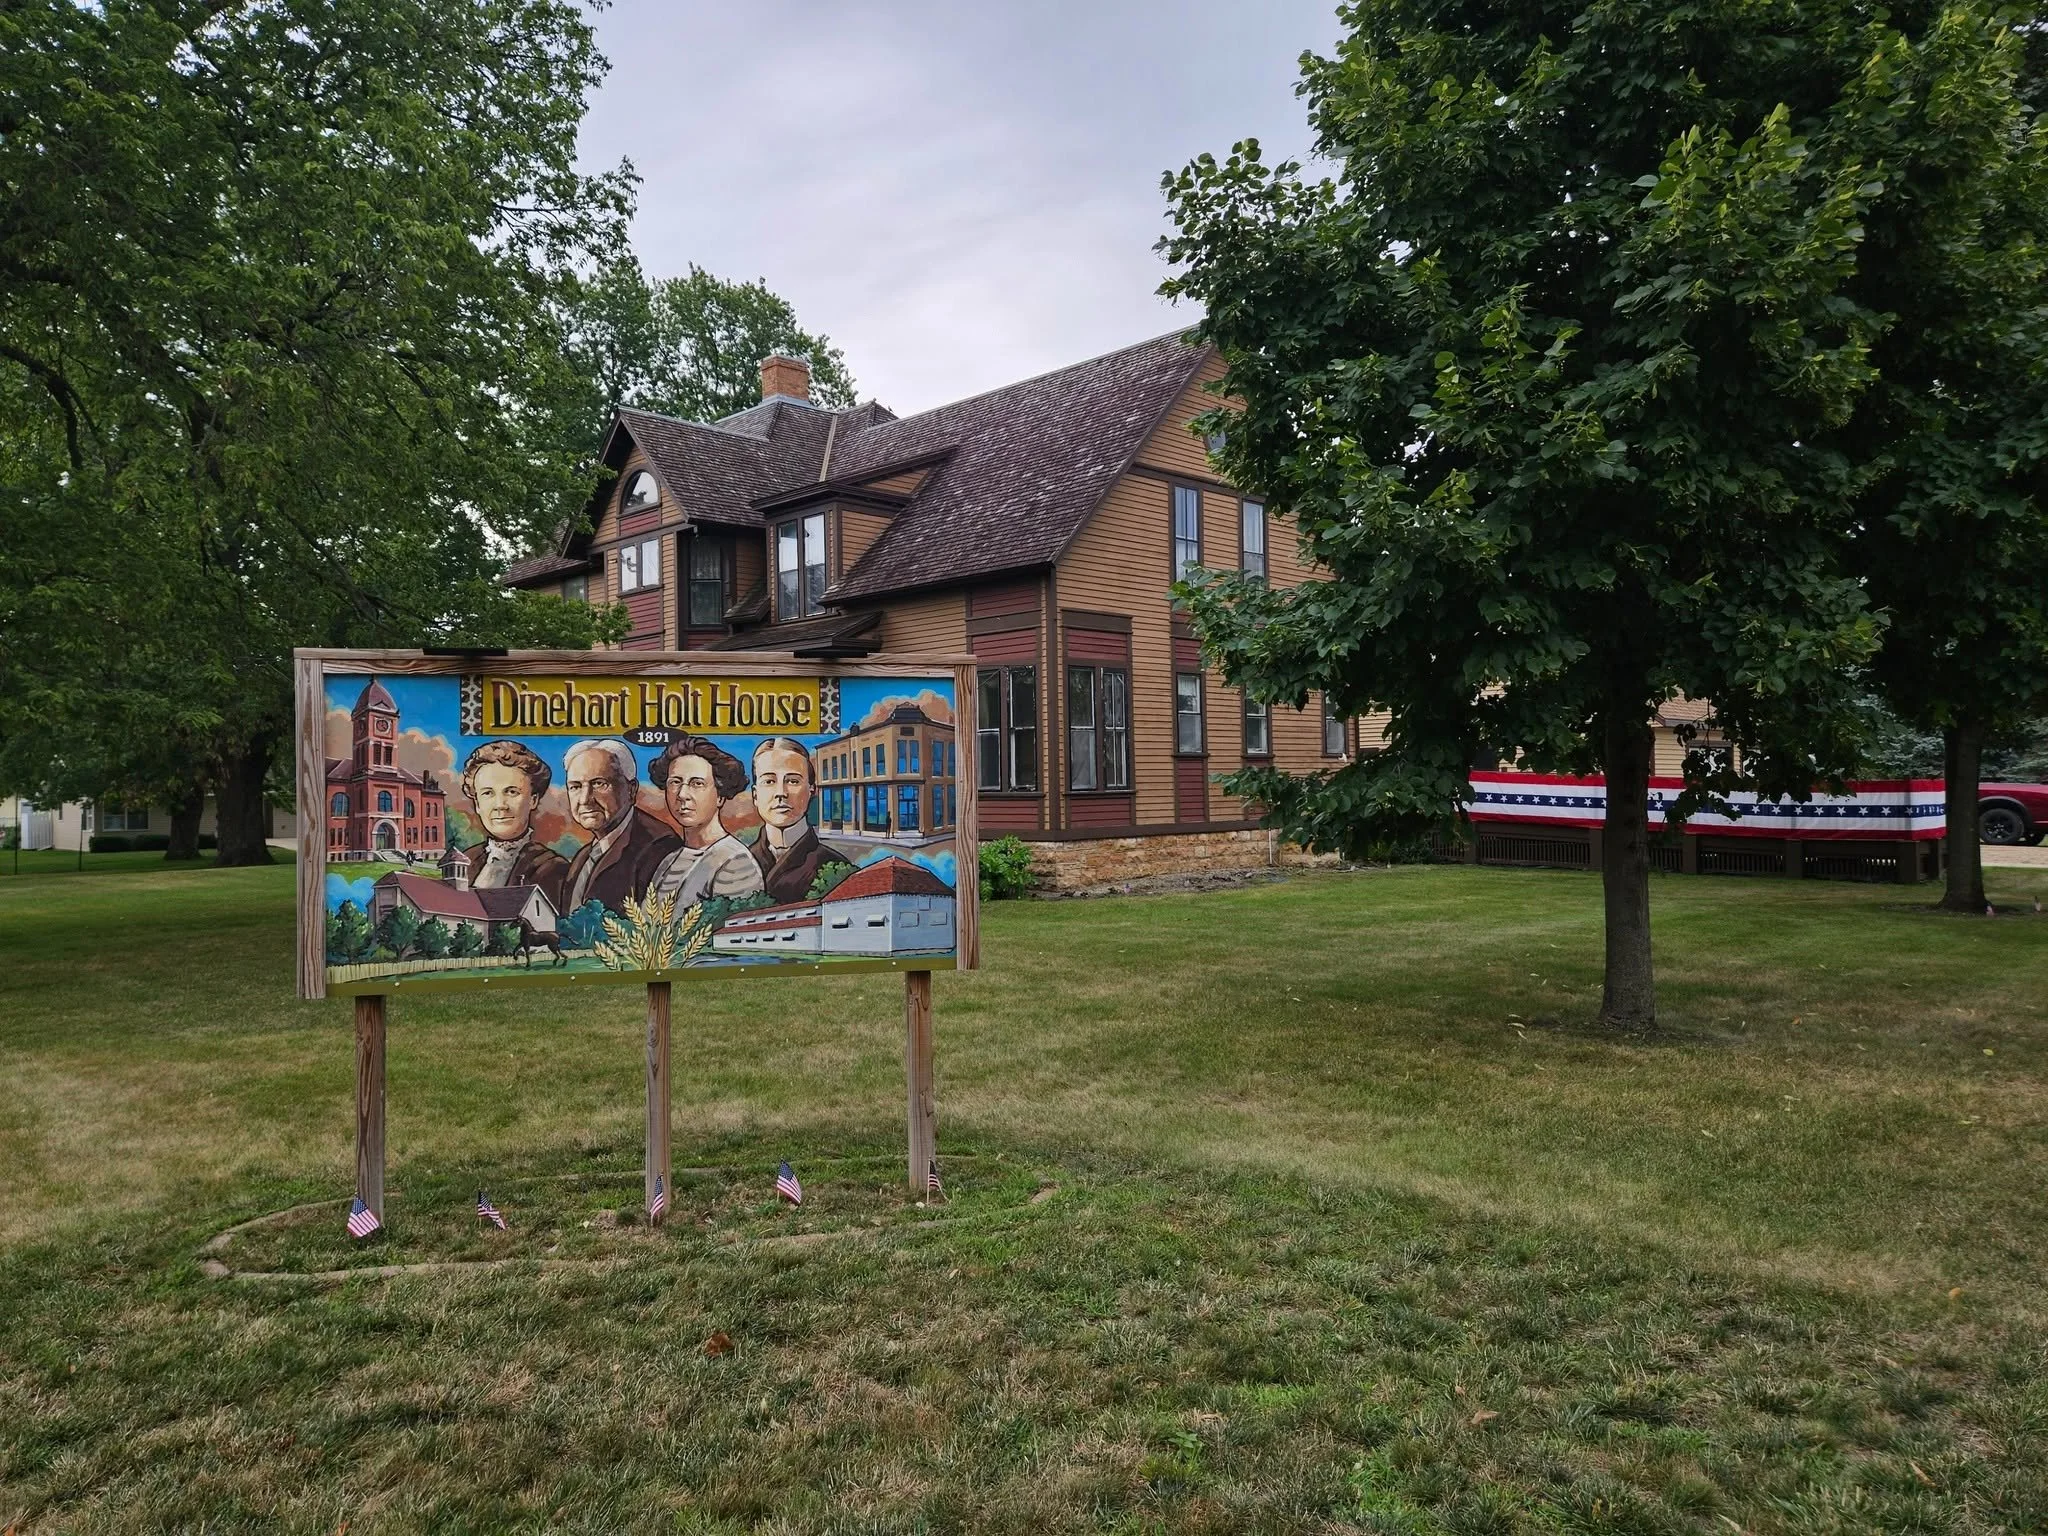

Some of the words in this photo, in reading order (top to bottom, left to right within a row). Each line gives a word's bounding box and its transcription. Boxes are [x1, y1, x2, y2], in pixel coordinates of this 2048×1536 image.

[491, 678, 631, 729] Dinehart
[638, 682, 702, 729] Holt
[709, 682, 812, 729] House
[637, 731, 669, 744] 1891
